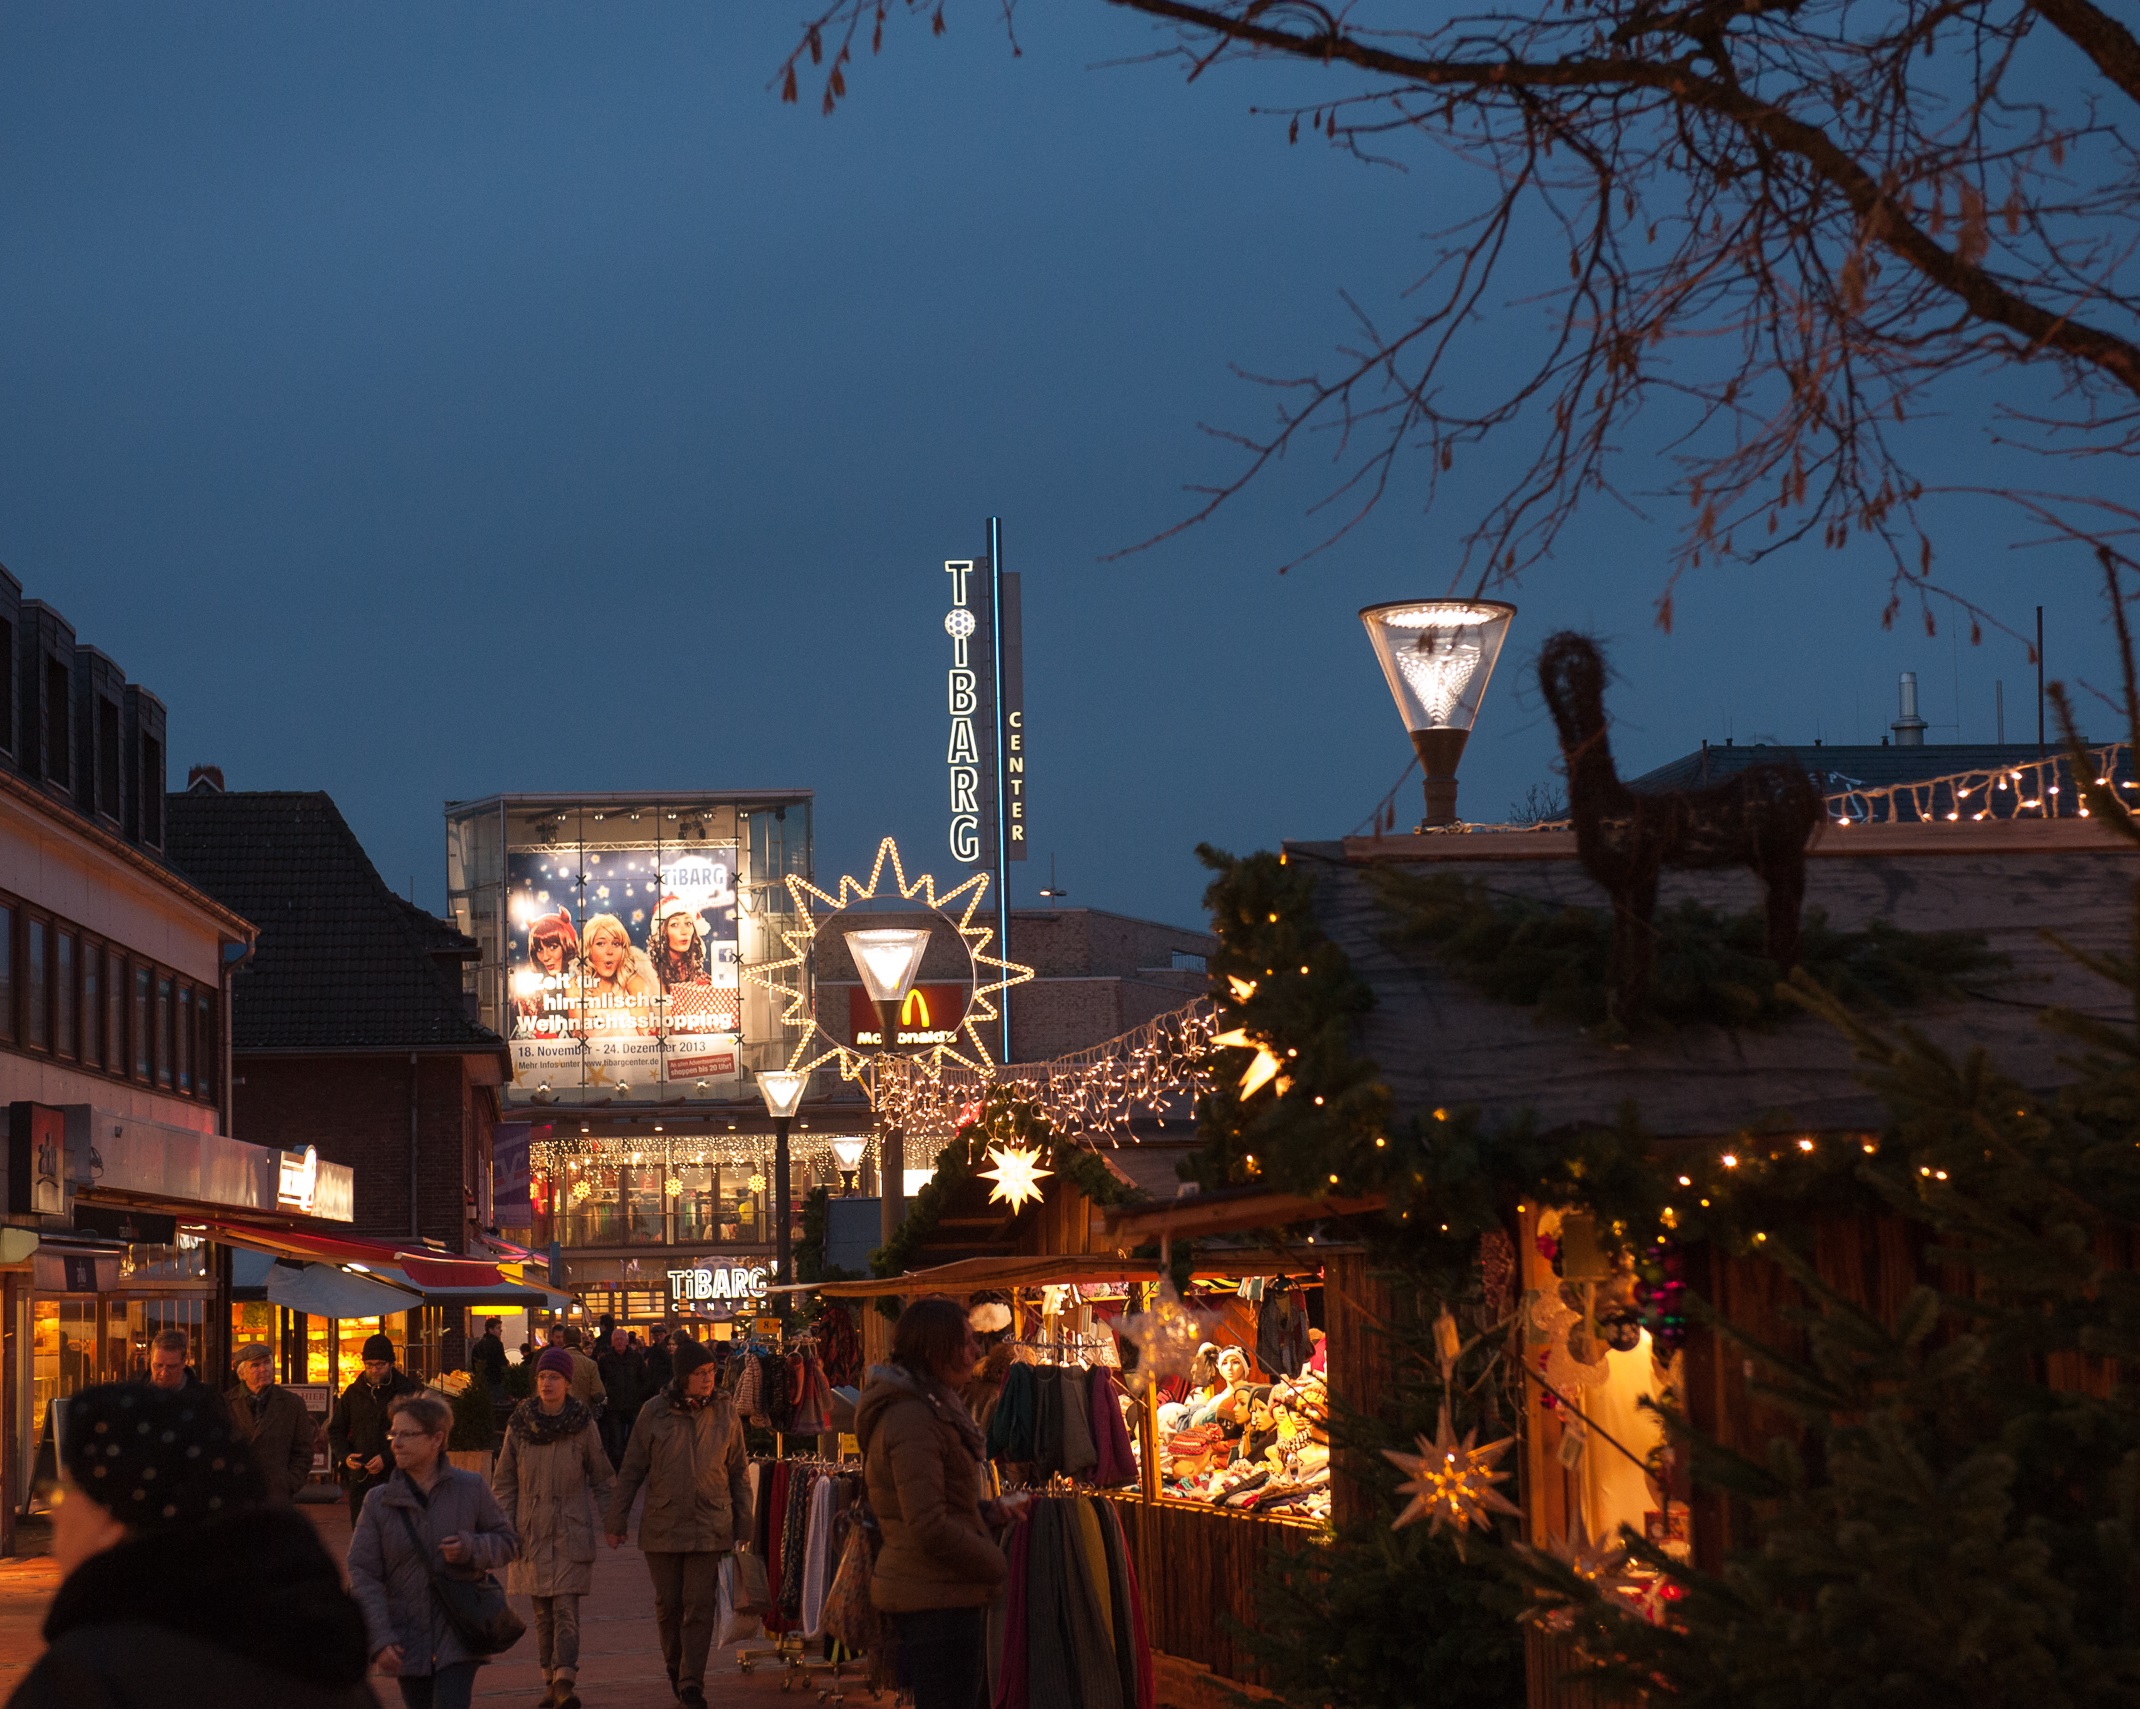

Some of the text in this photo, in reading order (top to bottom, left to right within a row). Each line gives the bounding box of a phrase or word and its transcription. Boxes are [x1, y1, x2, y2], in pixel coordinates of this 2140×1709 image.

[1008, 711, 1024, 841] CENTER
[543, 992, 674, 1011] himmlisches
[517, 1010, 732, 1032] Weihnachtsshopping
[857, 1030, 957, 1044] Mconald's
[518, 1046, 534, 1057] 18.
[537, 1044, 592, 1056] November
[603, 1043, 620, 1054] 24.
[679, 1041, 706, 1052] 2013
[518, 1061, 538, 1070] Mehr
[540, 1060, 557, 1069] Infos
[560, 1059, 581, 1068] unter
[670, 1067, 697, 1076] shoppen
[698, 1065, 708, 1073] bis
[671, 1301, 767, 1312] CENTER
[301, 1392, 326, 1401] HIER
